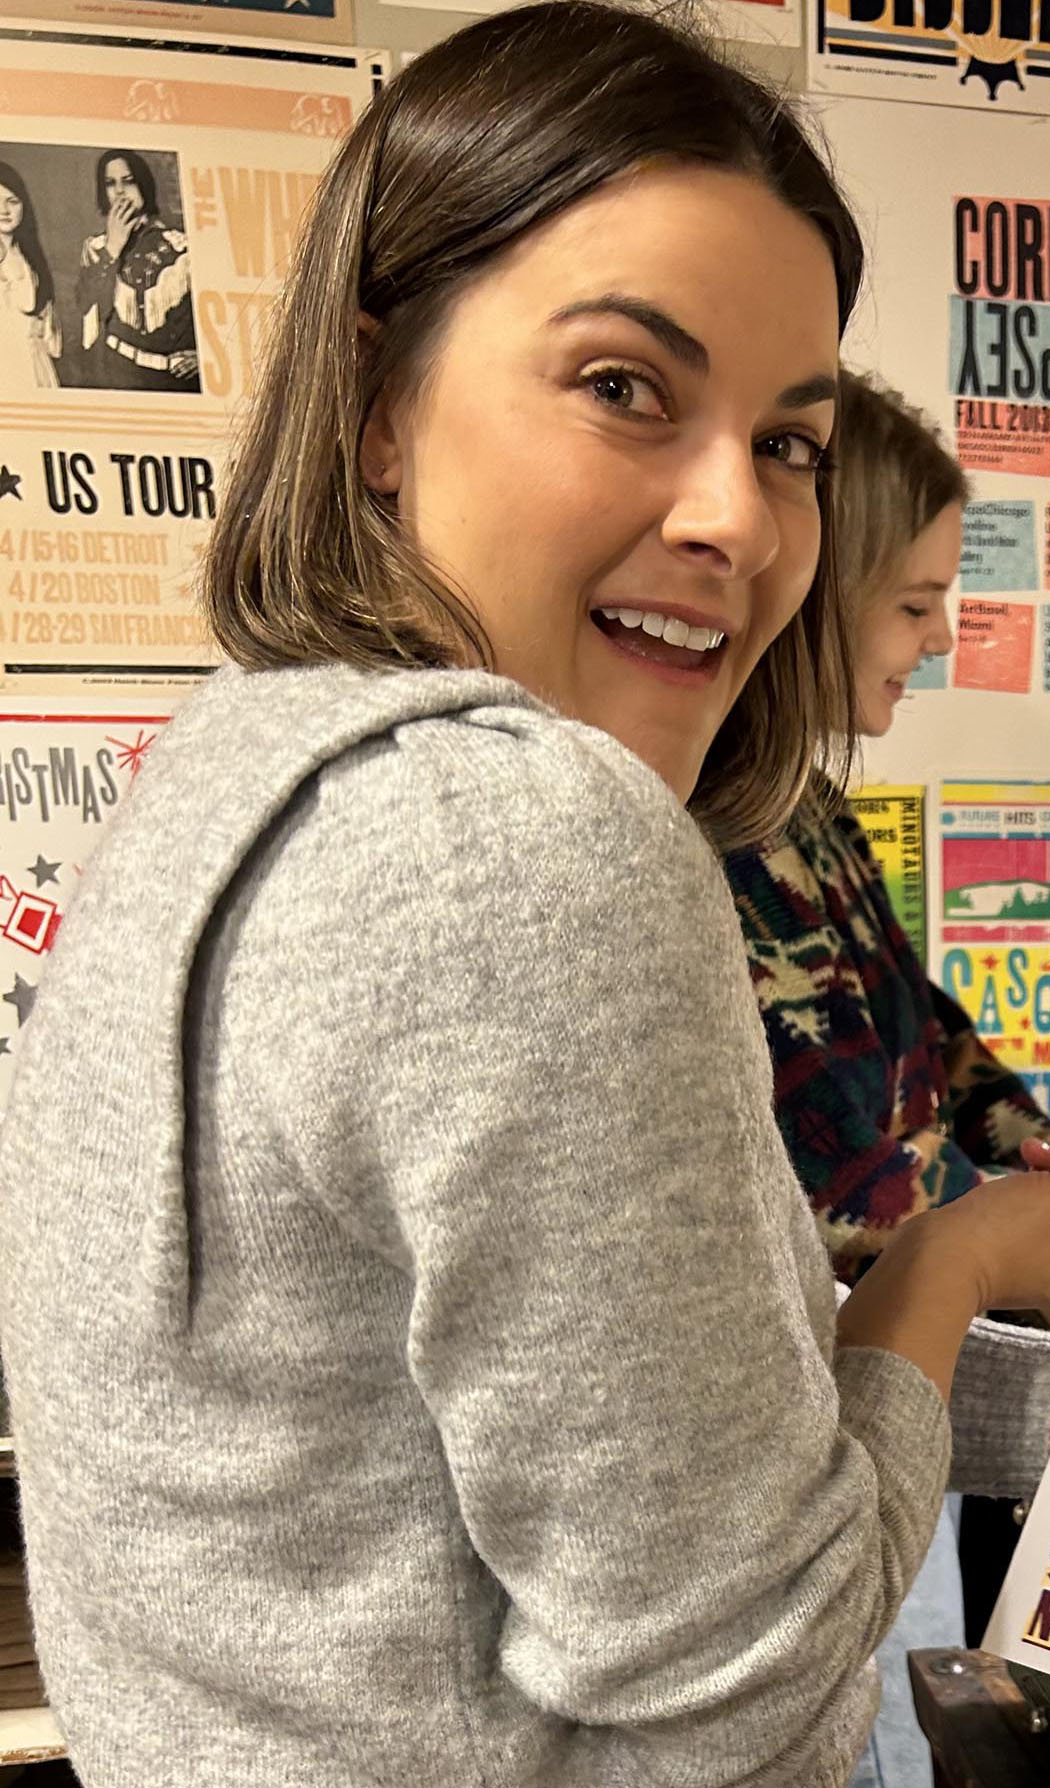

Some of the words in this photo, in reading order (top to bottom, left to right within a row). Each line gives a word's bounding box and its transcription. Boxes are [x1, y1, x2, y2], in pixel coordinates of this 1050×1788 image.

[955, 399, 1003, 431] FALL
[42, 450, 99, 515] US
[110, 452, 217, 520] TOUR
[81, 531, 169, 566] DETROIT
[75, 571, 161, 606] BOSTON
[0, 746, 119, 823] ISTMAS
